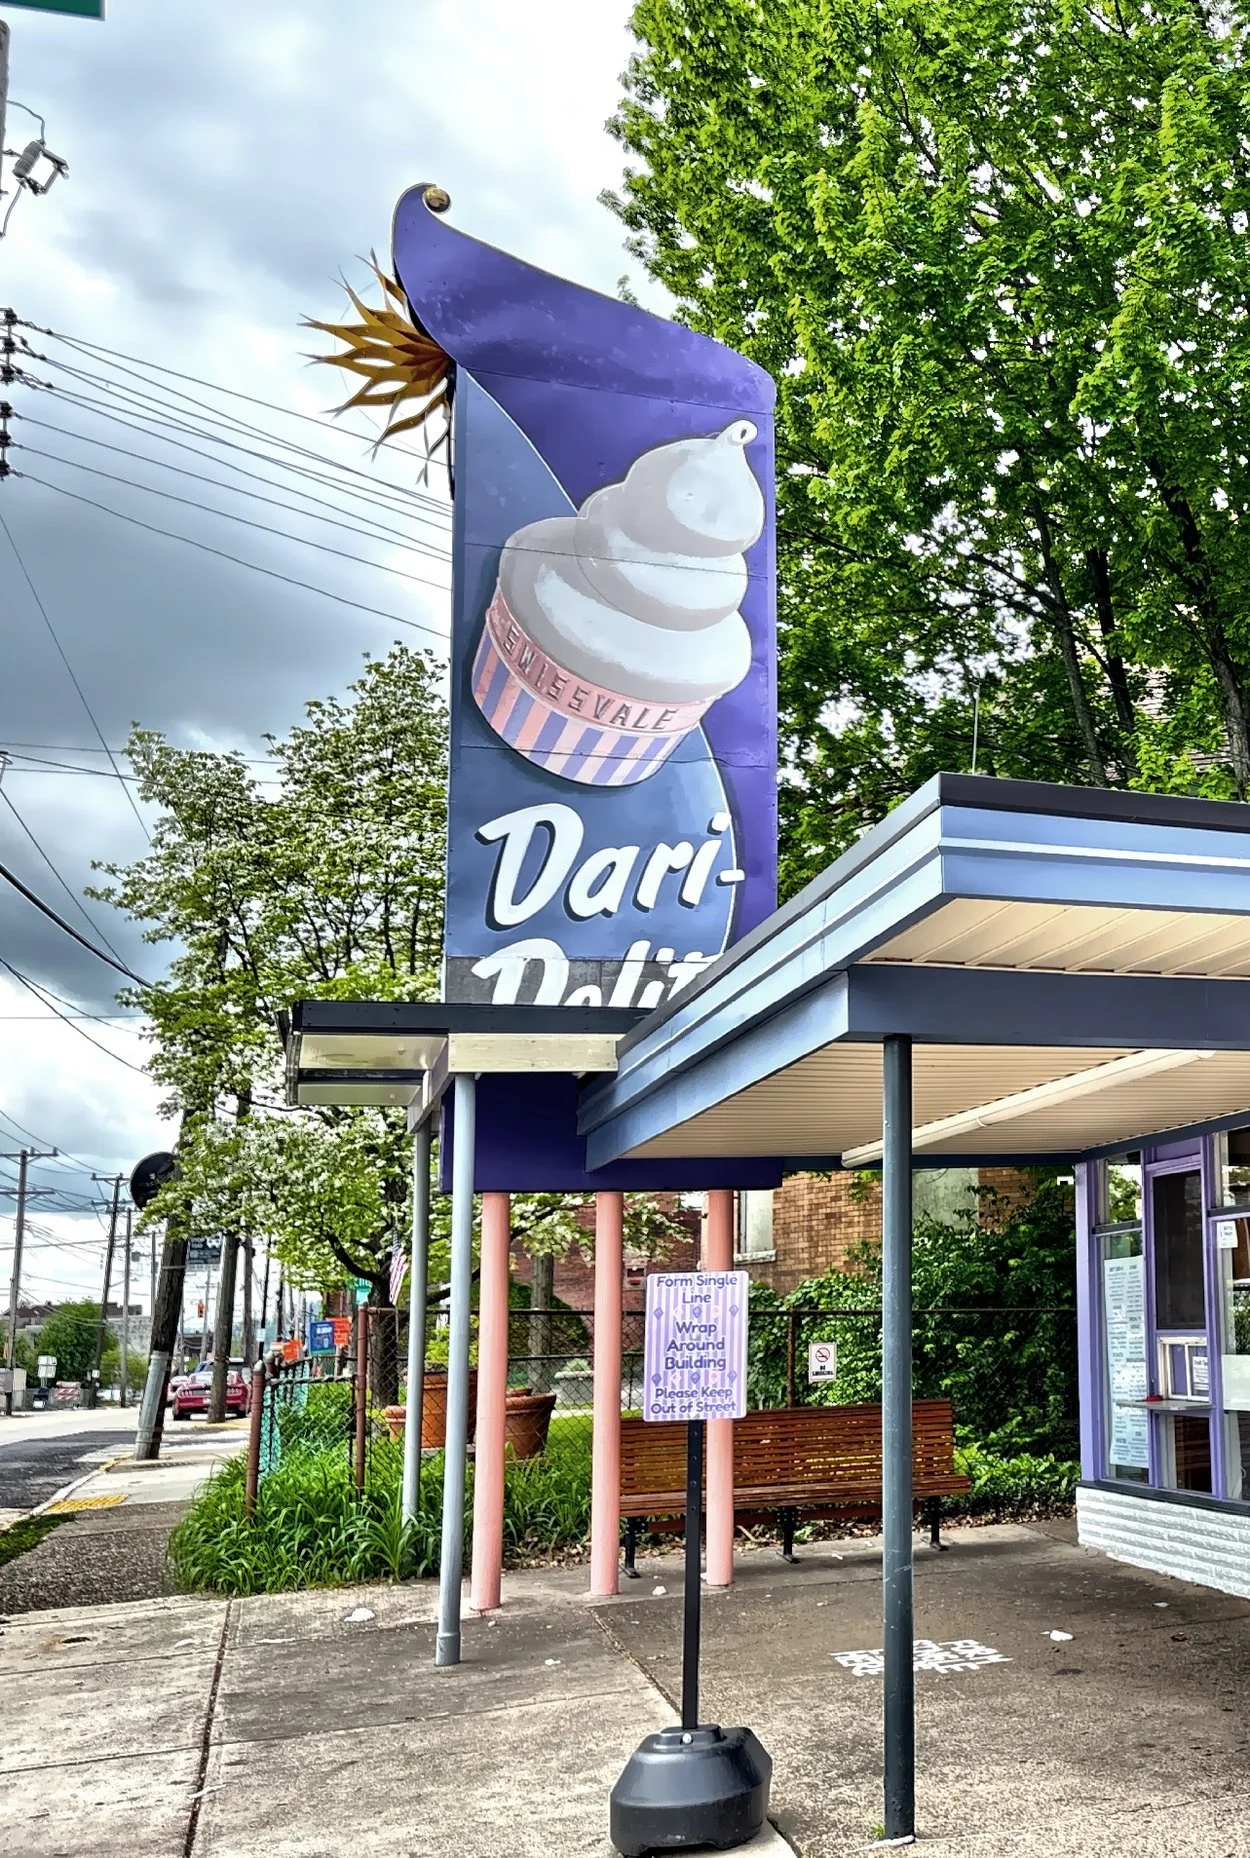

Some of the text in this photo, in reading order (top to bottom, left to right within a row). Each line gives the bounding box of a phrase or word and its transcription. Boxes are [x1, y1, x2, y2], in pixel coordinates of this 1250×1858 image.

[501, 625, 679, 732] SWISSVALE
[477, 803, 745, 929] Dari-
[657, 1273, 738, 1289] Form Single
[682, 1291, 712, 1304] Line
[676, 1321, 718, 1336] Wrap
[667, 1337, 725, 1352] Around
[665, 1355, 727, 1371] Building
[655, 1387, 733, 1400] Please Keep
[651, 1401, 737, 1414] Out of Street
